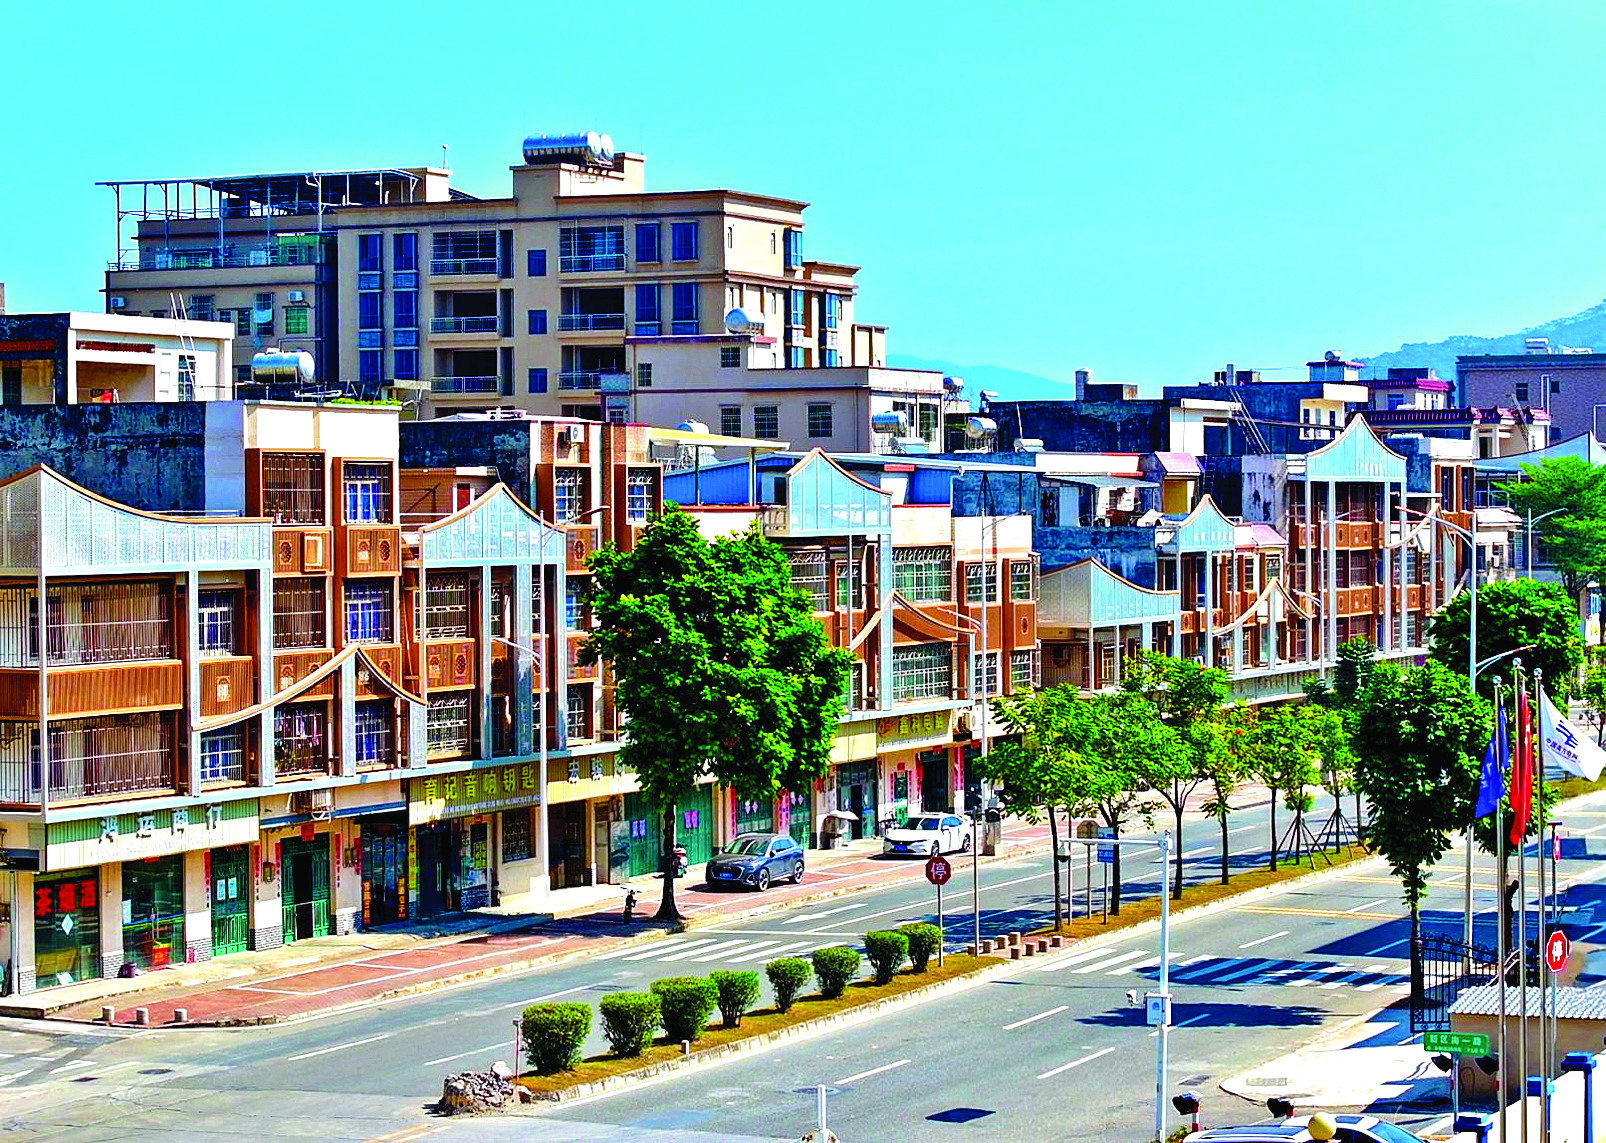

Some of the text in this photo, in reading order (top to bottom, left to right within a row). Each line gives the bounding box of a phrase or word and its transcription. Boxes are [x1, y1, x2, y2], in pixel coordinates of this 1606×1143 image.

[1546, 738, 1579, 760] 中国南方电网
[930, 862, 948, 879] 停
[1551, 940, 1563, 962] 停
